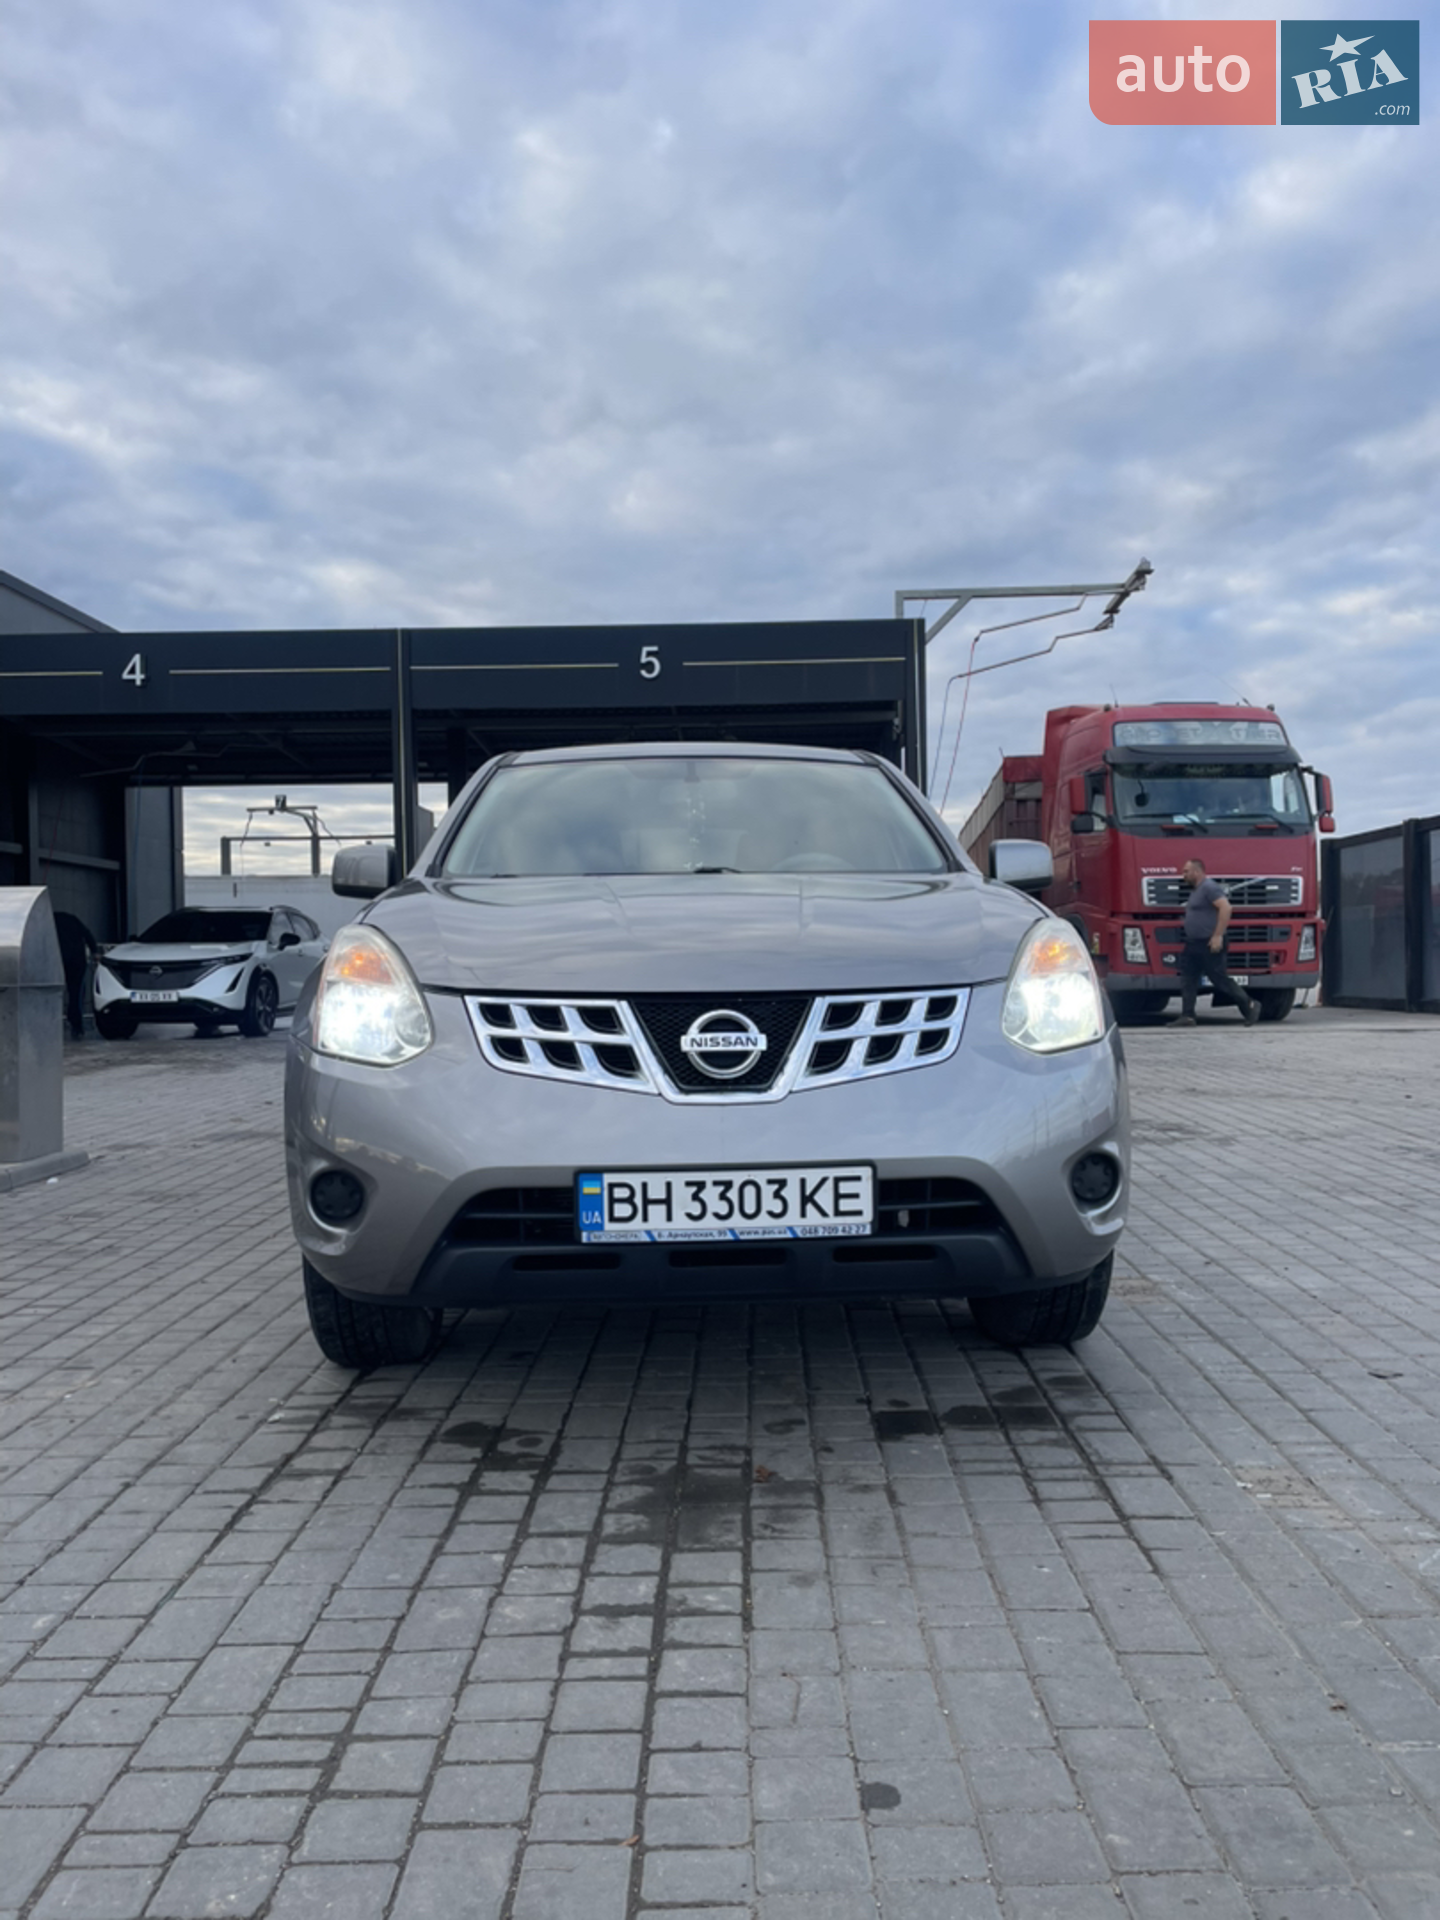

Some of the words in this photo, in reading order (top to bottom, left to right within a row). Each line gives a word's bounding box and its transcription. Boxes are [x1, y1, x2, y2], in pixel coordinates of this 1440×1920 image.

[121, 653, 146, 686] 4
[639, 646, 661, 679] 5
[1140, 866, 1178, 874] VOLVO
[690, 1035, 758, 1048] NISSAN
[607, 1180, 673, 1223] BH
[684, 1178, 789, 1222] 3303
[800, 1175, 863, 1219] KE
[582, 1210, 602, 1225] UA
